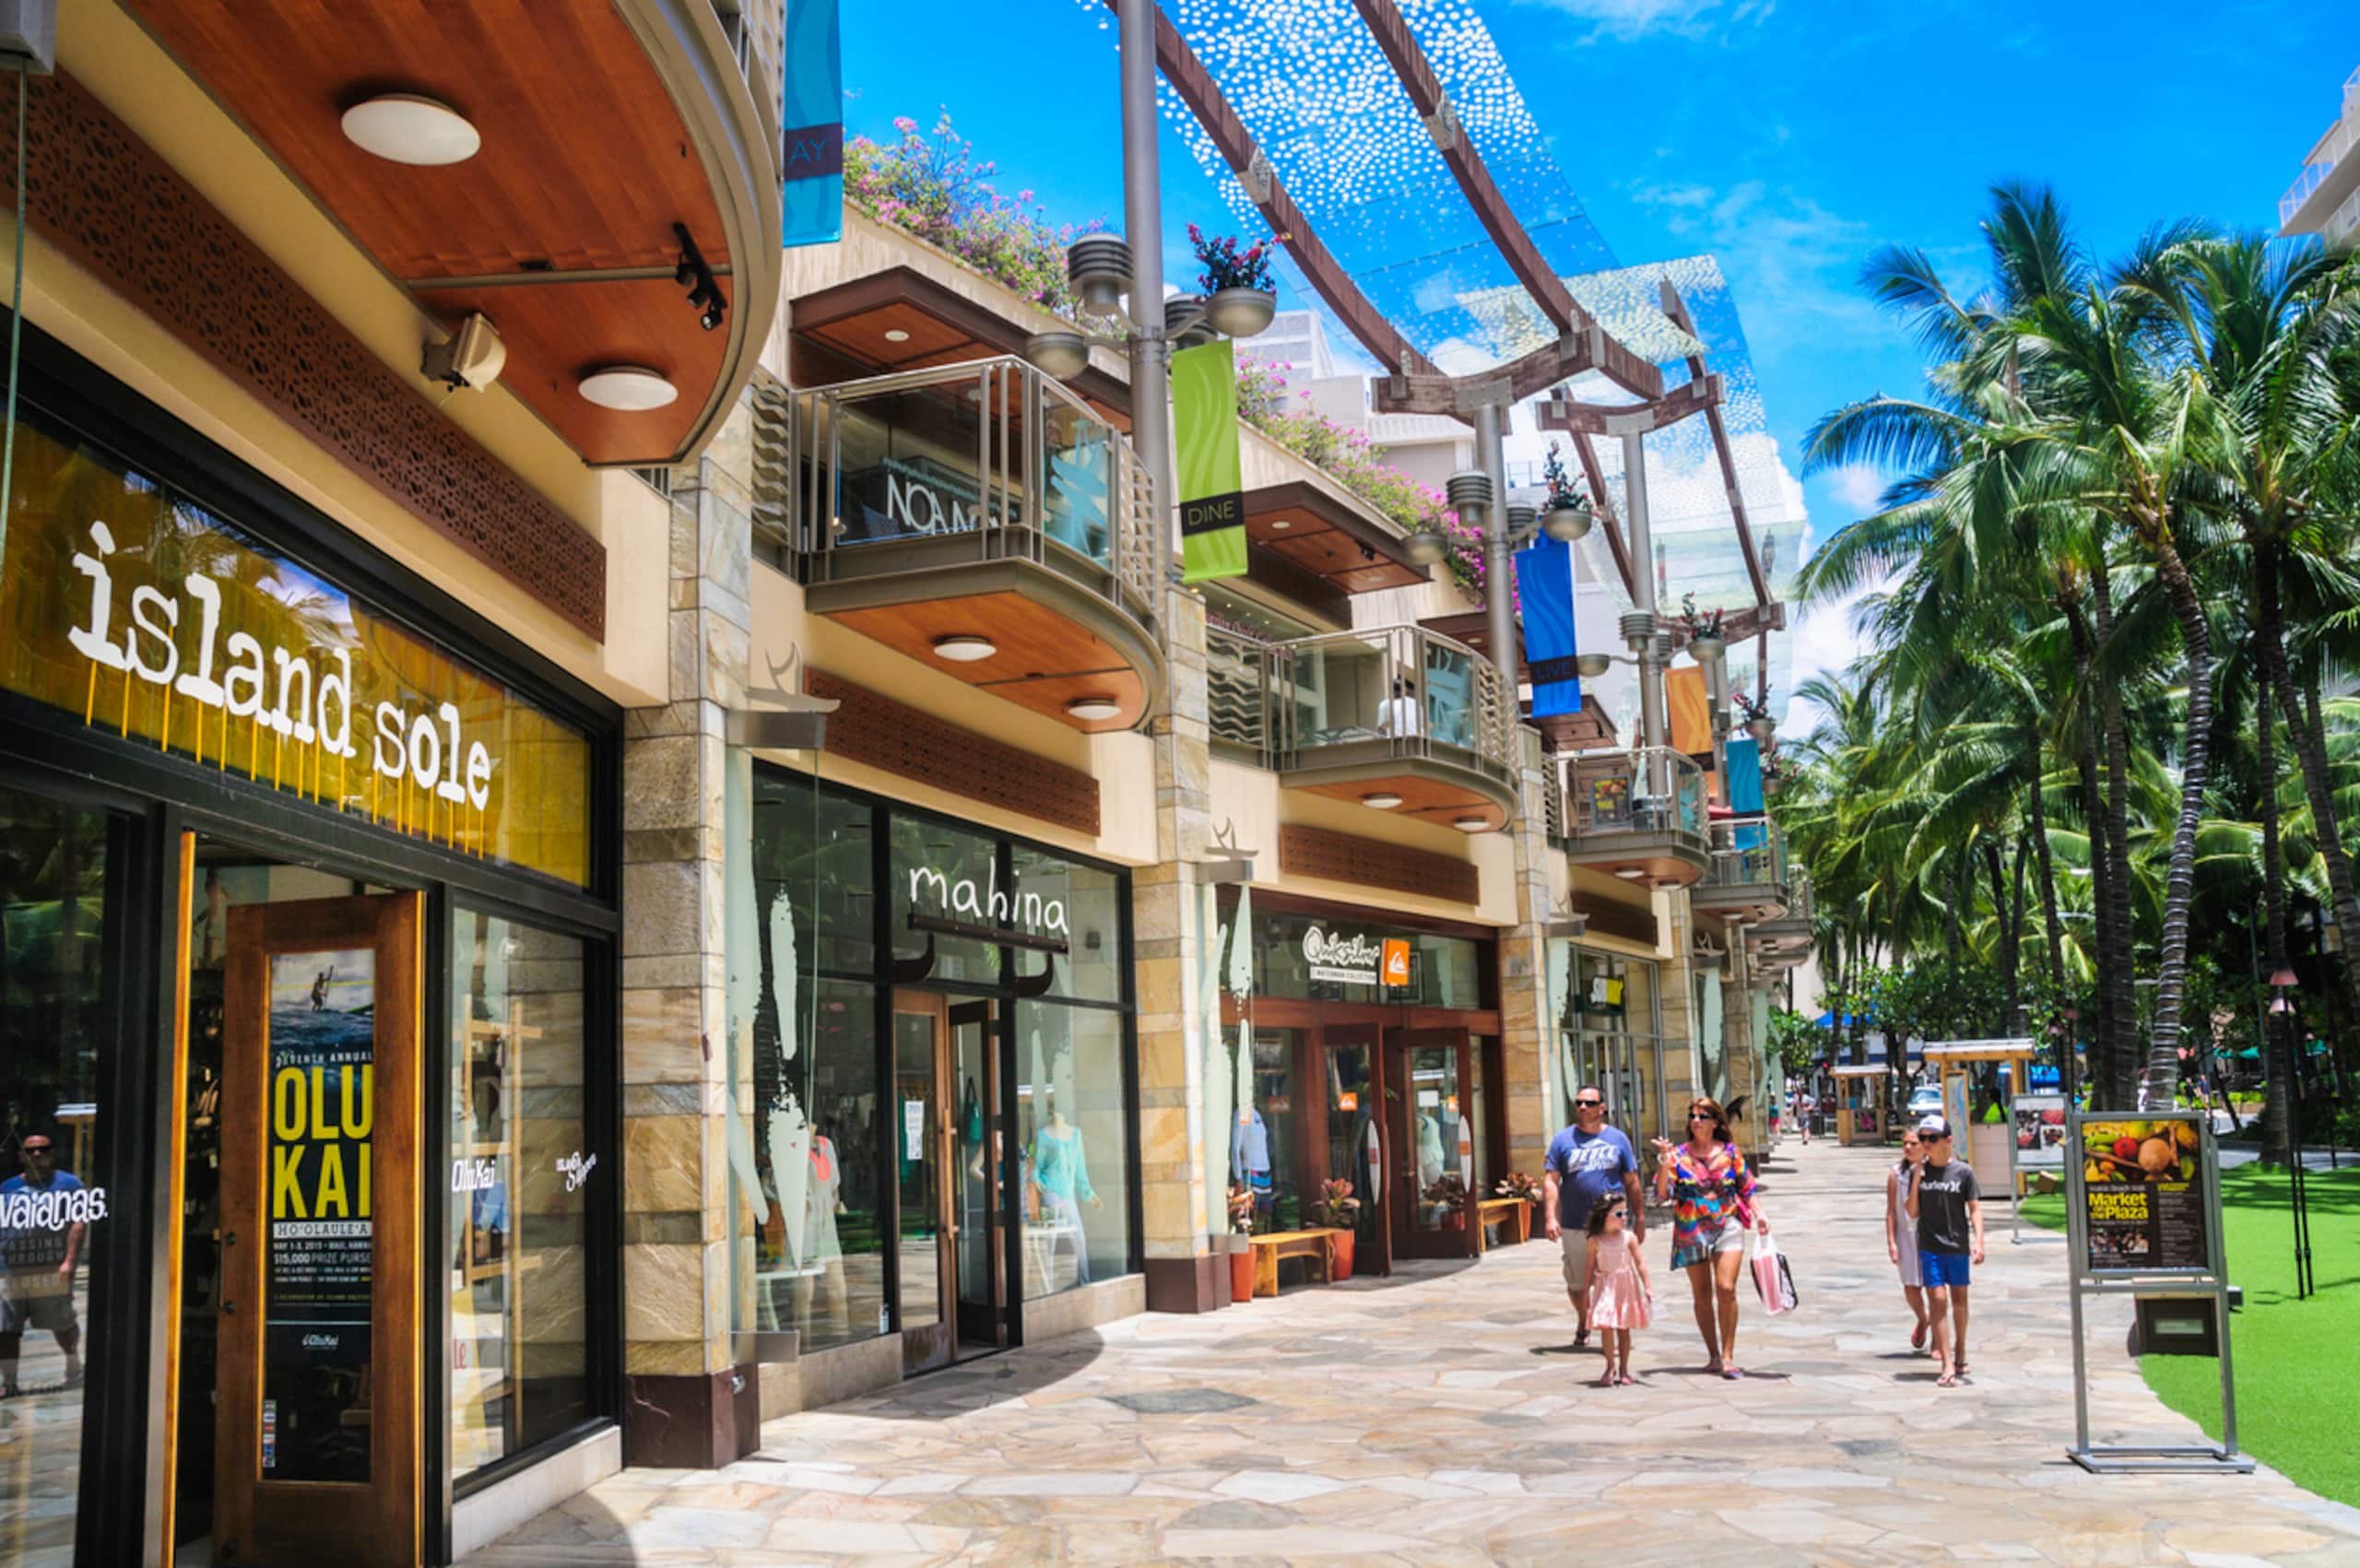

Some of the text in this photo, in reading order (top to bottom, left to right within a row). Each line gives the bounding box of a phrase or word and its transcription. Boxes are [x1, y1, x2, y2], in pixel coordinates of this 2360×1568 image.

[887, 474, 950, 536] NOA
[1187, 501, 1235, 526] DINE
[68, 520, 491, 810] island sole
[910, 855, 1069, 935] mahina
[274, 1065, 372, 1141] OLU
[273, 1143, 371, 1219] KAI
[2088, 1192, 2147, 1206] Market
[2106, 1206, 2149, 1220] Plaza
